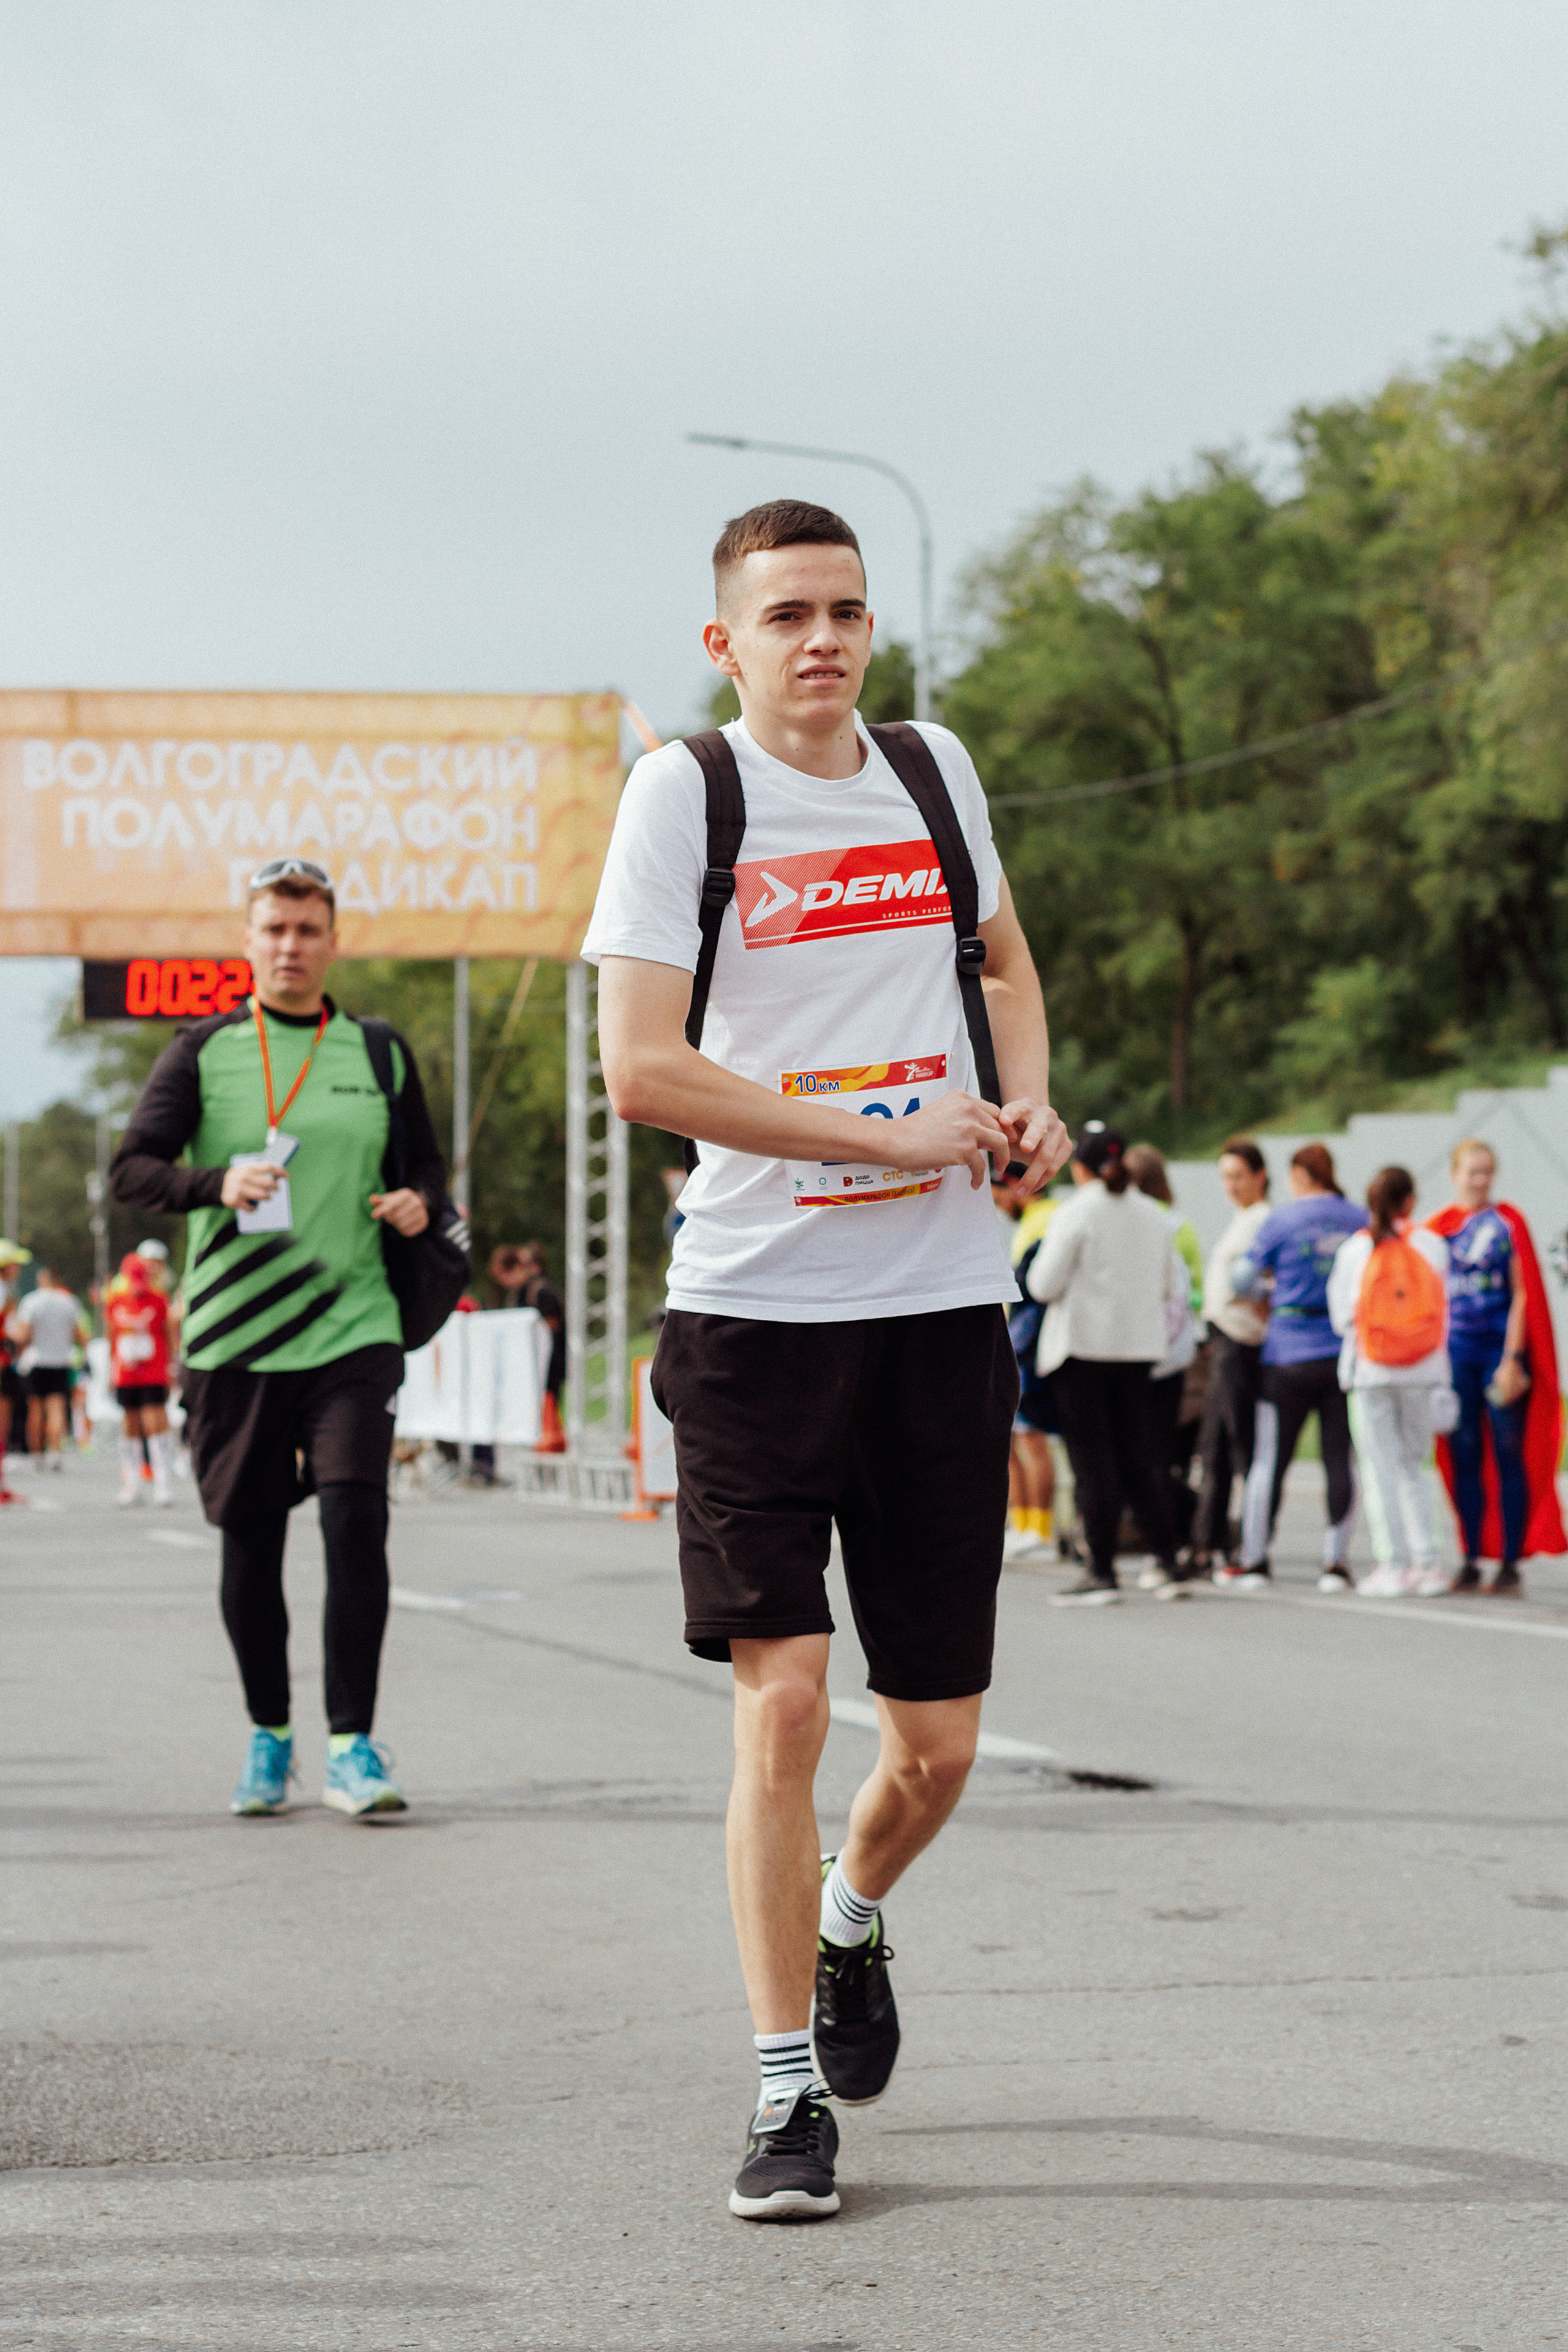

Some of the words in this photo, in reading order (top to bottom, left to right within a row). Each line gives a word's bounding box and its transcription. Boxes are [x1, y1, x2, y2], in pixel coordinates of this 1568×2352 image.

[23, 737, 537, 794] ВОЛГОГРАДСКИЙ
[62, 797, 537, 850] ПОЛУМАРАФОН
[229, 860, 538, 916] ГДИКАП
[801, 868, 948, 910] DEMI
[845, 1191, 890, 1202] ПОЛУМАРАФОН
[883, 1170, 903, 1182] СТС
